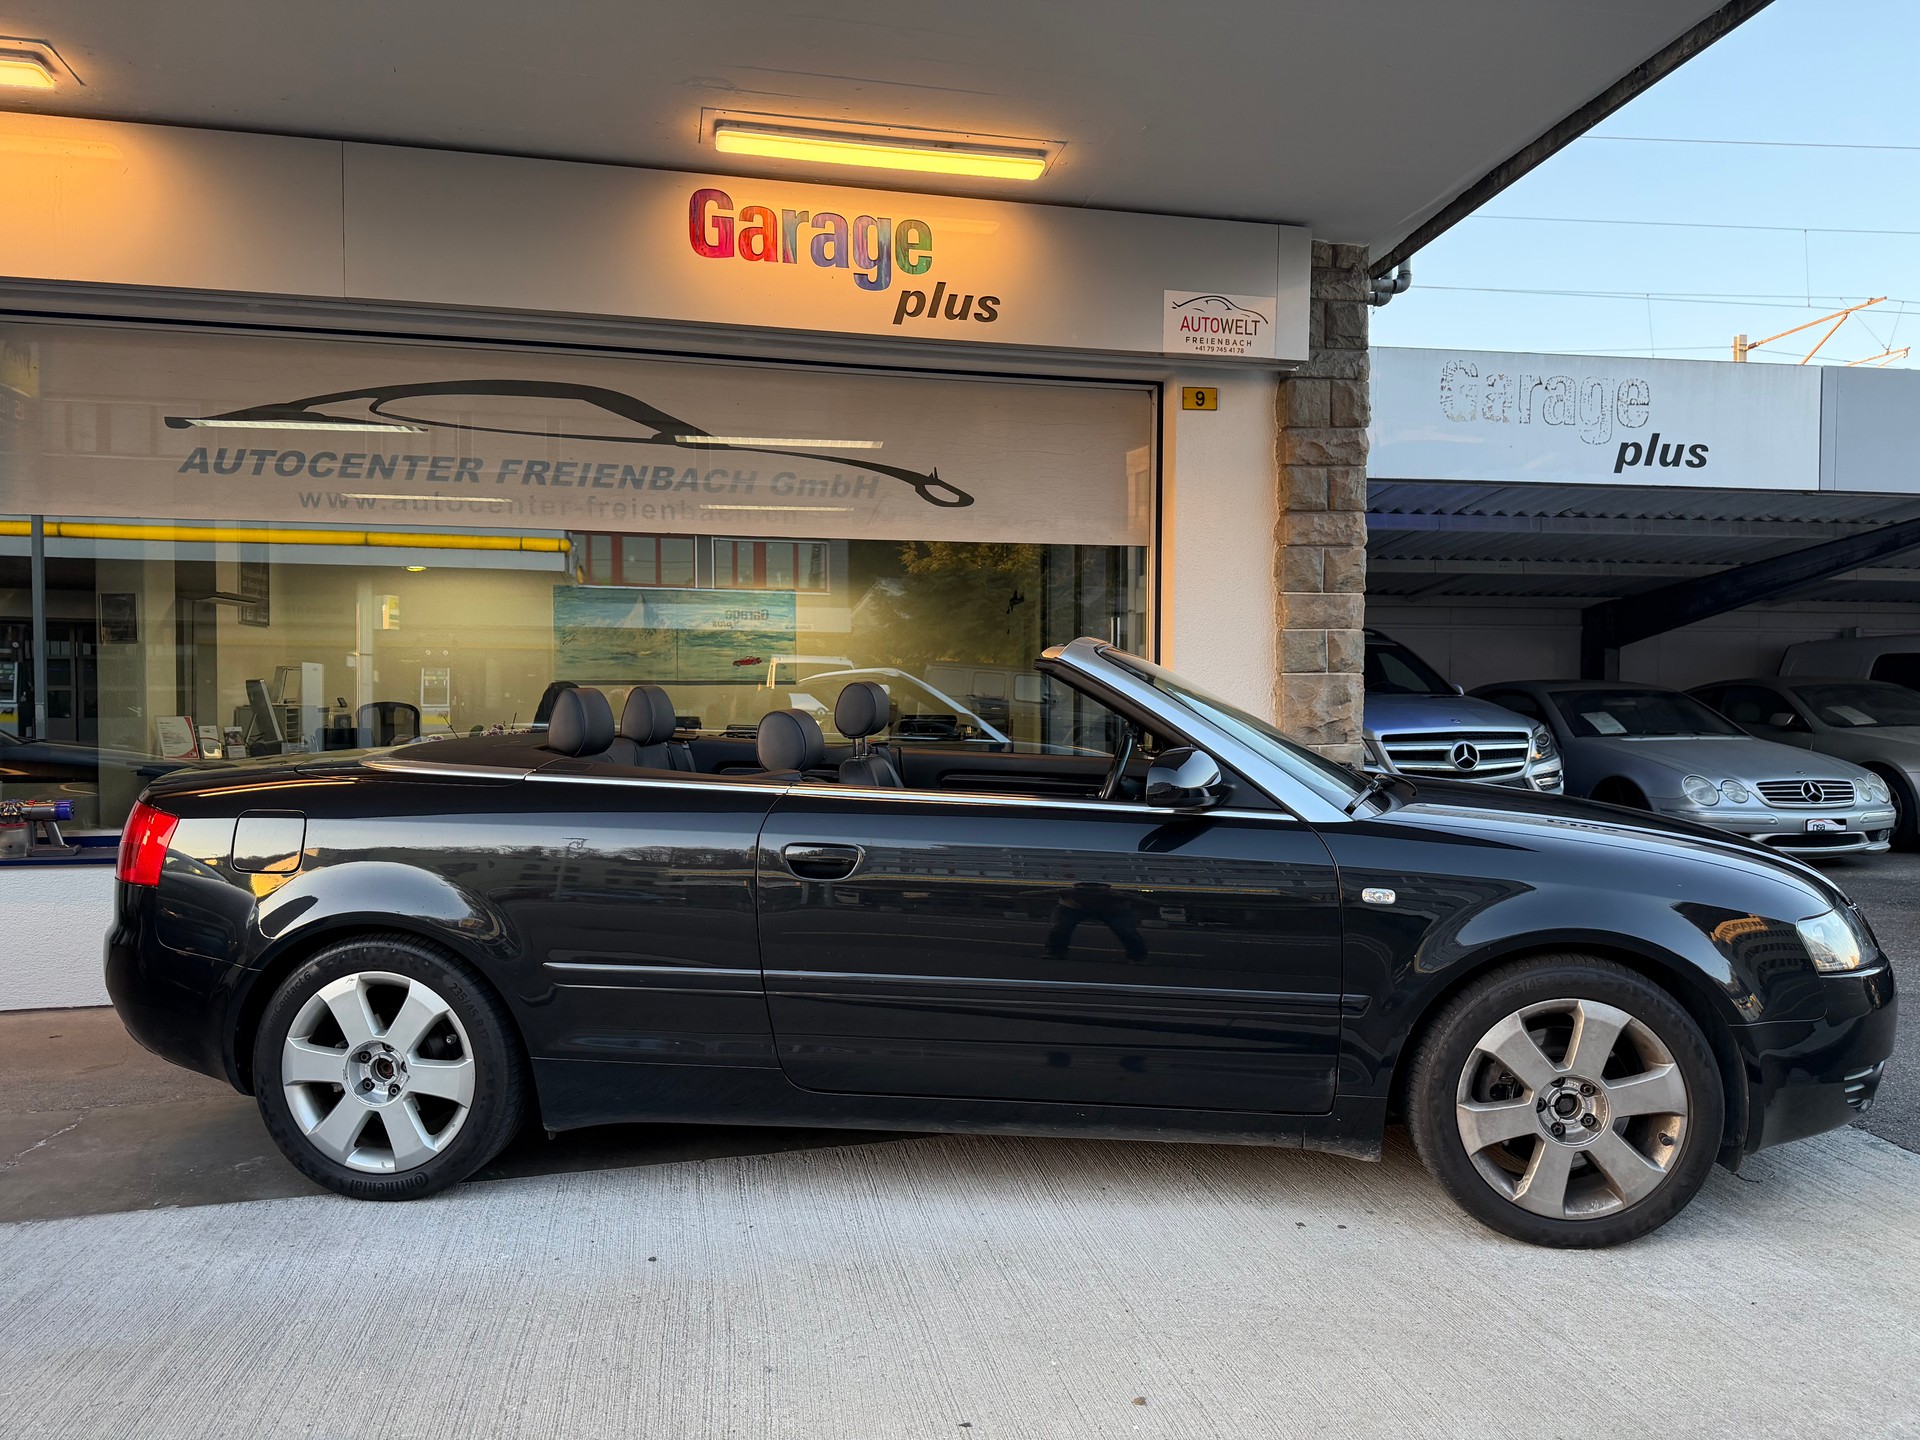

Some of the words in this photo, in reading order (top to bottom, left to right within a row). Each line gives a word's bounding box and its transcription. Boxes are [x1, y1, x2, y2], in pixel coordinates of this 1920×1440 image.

[689, 188, 933, 291] Garage
[892, 281, 1001, 325] plus
[1180, 316, 1260, 336] AUTOWELT
[1185, 337, 1252, 347] FREIENBACH
[1195, 391, 1205, 407] 9
[1439, 358, 1651, 446] Garage
[177, 446, 485, 484] AUTOCENTER
[496, 458, 759, 495] FREIENBACH
[769, 471, 881, 500] GmbH
[1613, 432, 1710, 474] plus
[349, 1170, 429, 1194] Continental
